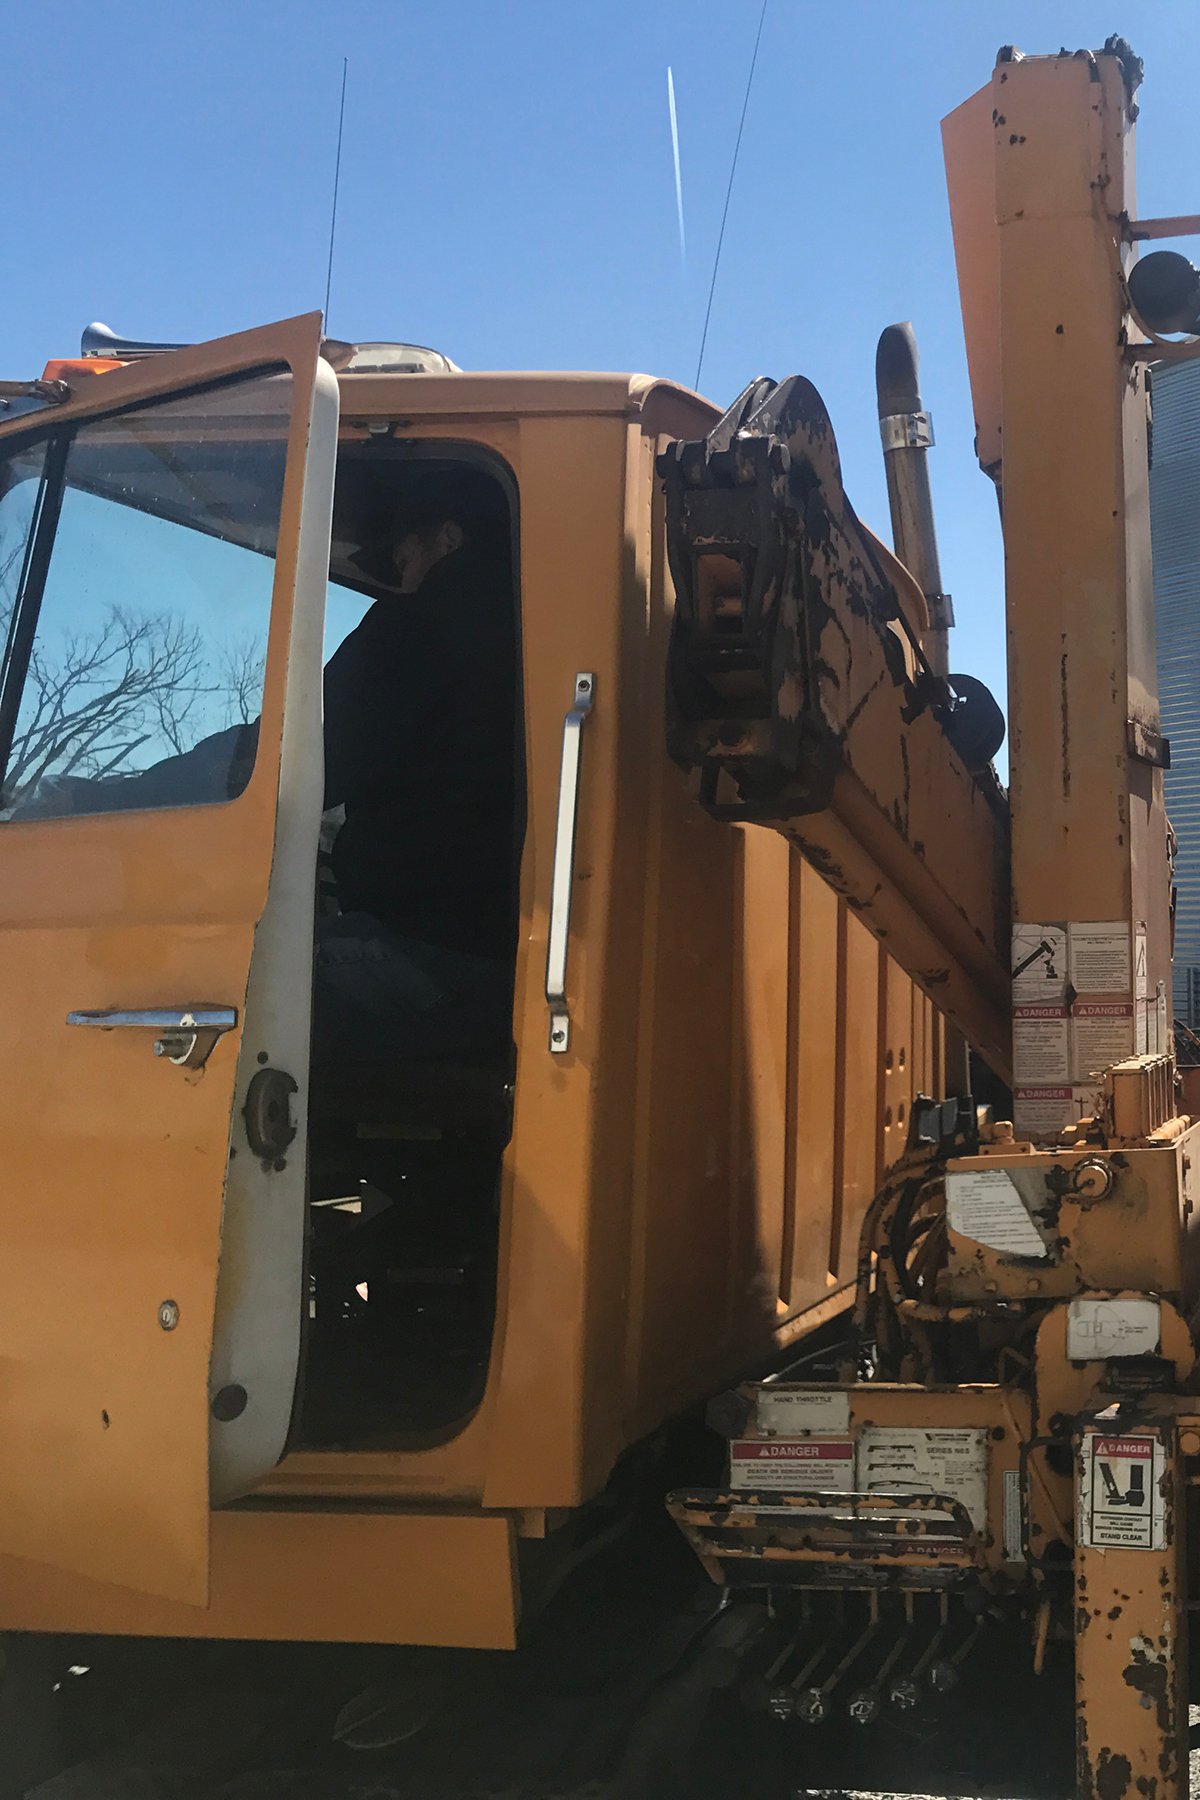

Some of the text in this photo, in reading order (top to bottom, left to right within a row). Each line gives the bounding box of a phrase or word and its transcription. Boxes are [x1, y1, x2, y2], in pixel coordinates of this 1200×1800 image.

[1088, 1007, 1126, 1015] DANGER
[771, 1447, 819, 1456] DANGER
[1109, 1444, 1150, 1453] DANGER
